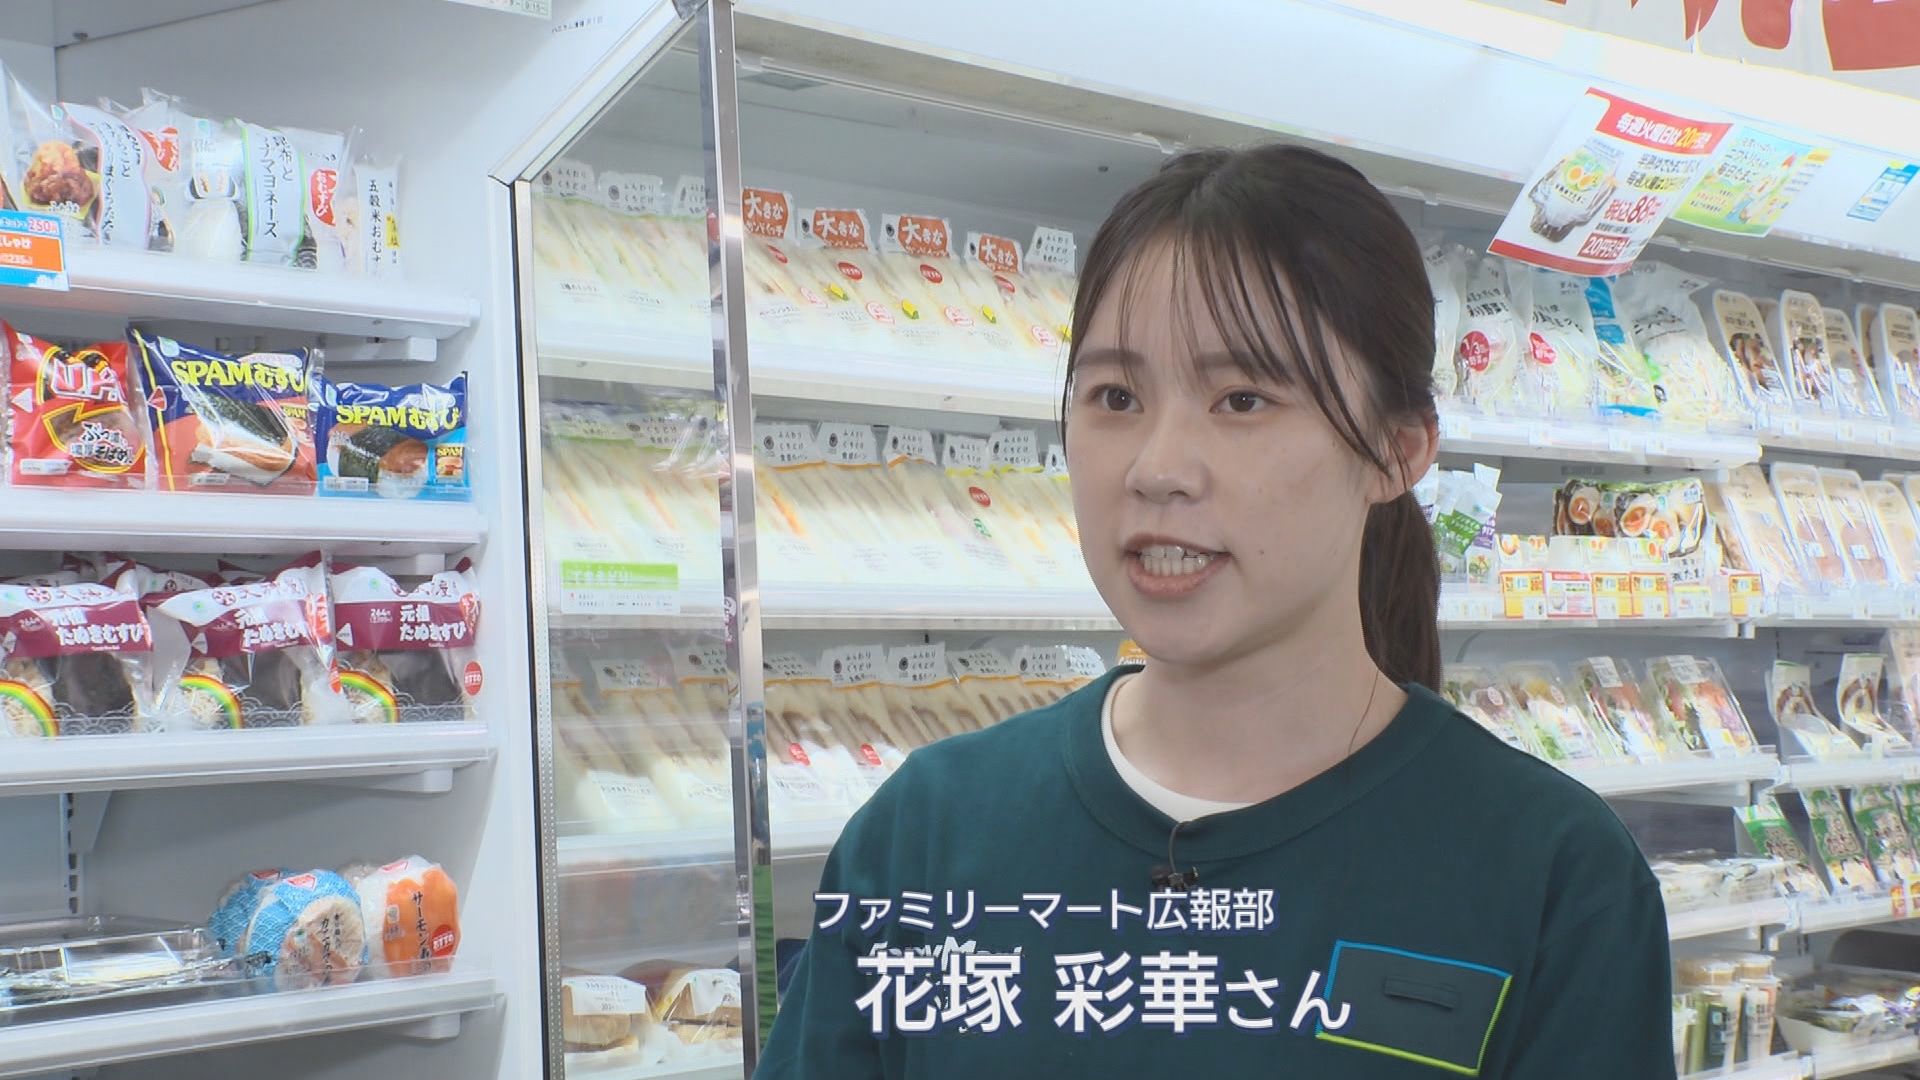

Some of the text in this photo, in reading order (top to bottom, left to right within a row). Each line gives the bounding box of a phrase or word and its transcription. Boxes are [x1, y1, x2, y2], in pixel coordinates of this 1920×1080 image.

[744, 191, 784, 220] 大きな
[816, 211, 860, 238] 大きな
[902, 218, 944, 245] 大きな
[981, 238, 1015, 266] 大きな
[437, 446, 463, 457] SPAM
[401, 604, 430, 622] 元祖
